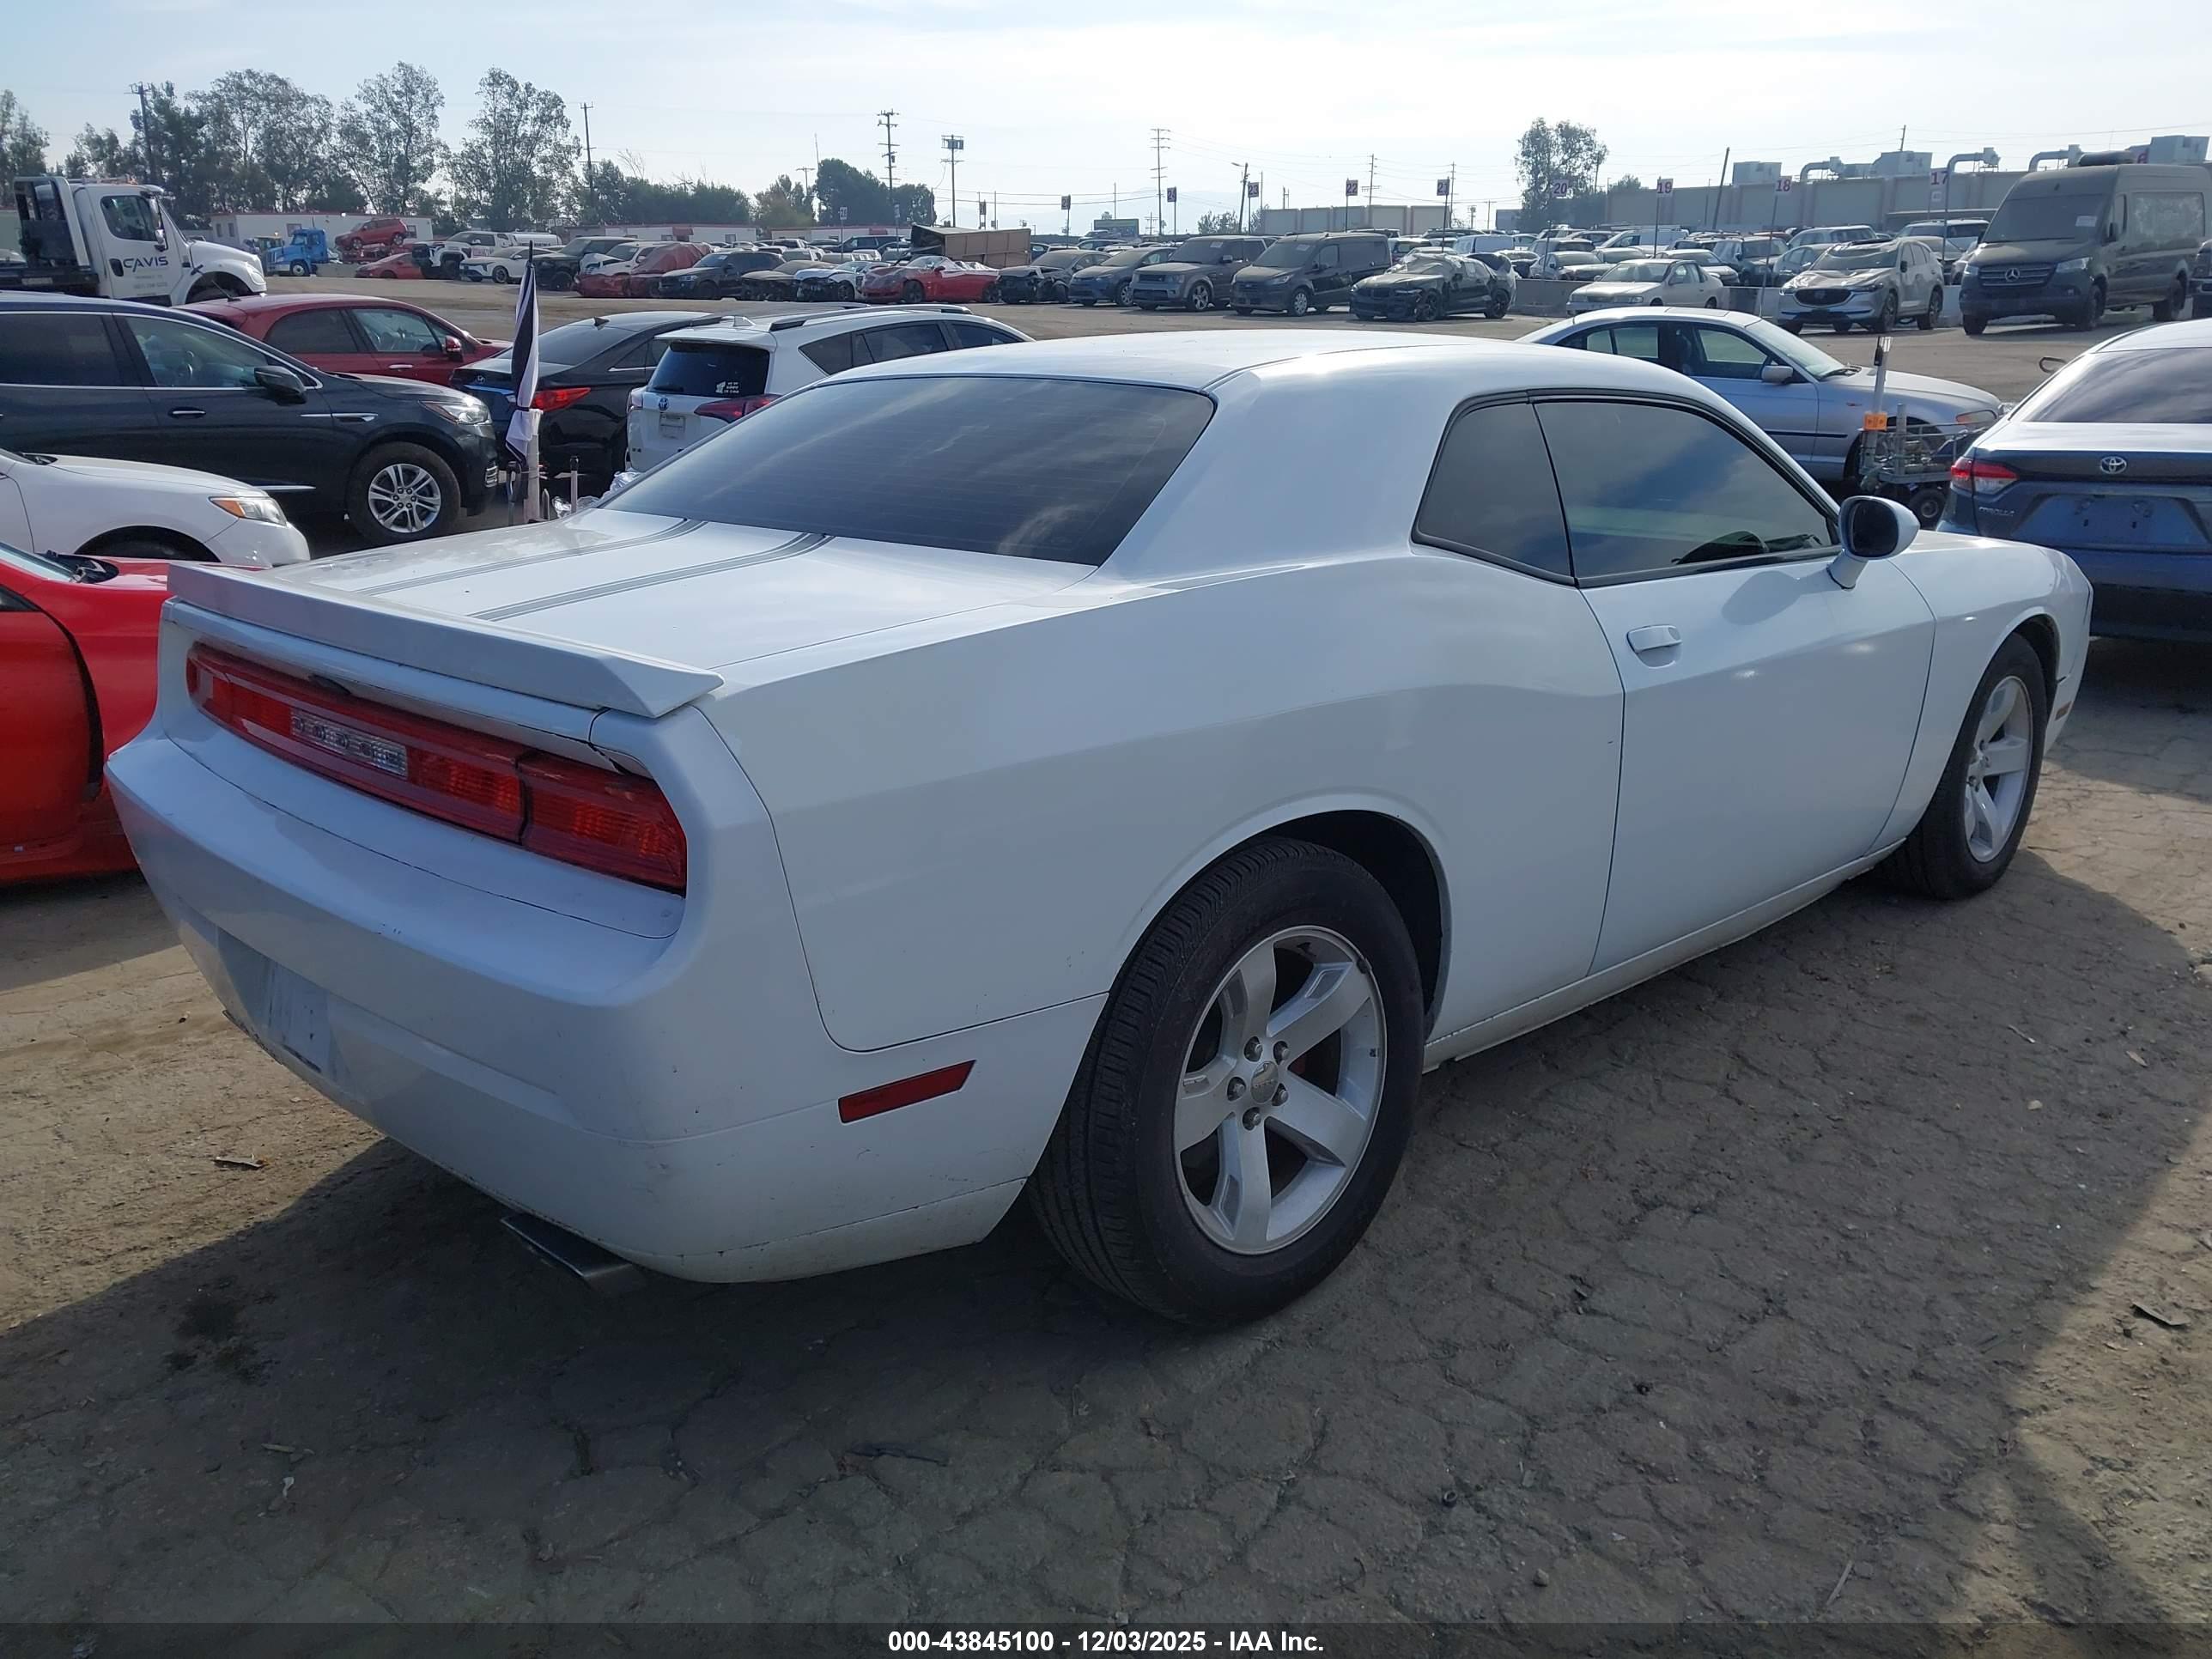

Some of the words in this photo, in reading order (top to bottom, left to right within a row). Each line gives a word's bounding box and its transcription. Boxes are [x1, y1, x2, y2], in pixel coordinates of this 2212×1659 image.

[1930, 170, 1950, 185] 17
[1346, 183, 1358, 193] 22
[1553, 183, 1567, 194] 20
[1657, 181, 1673, 193] 19
[1776, 179, 1791, 191] 18
[123, 256, 168, 272] CAVIS
